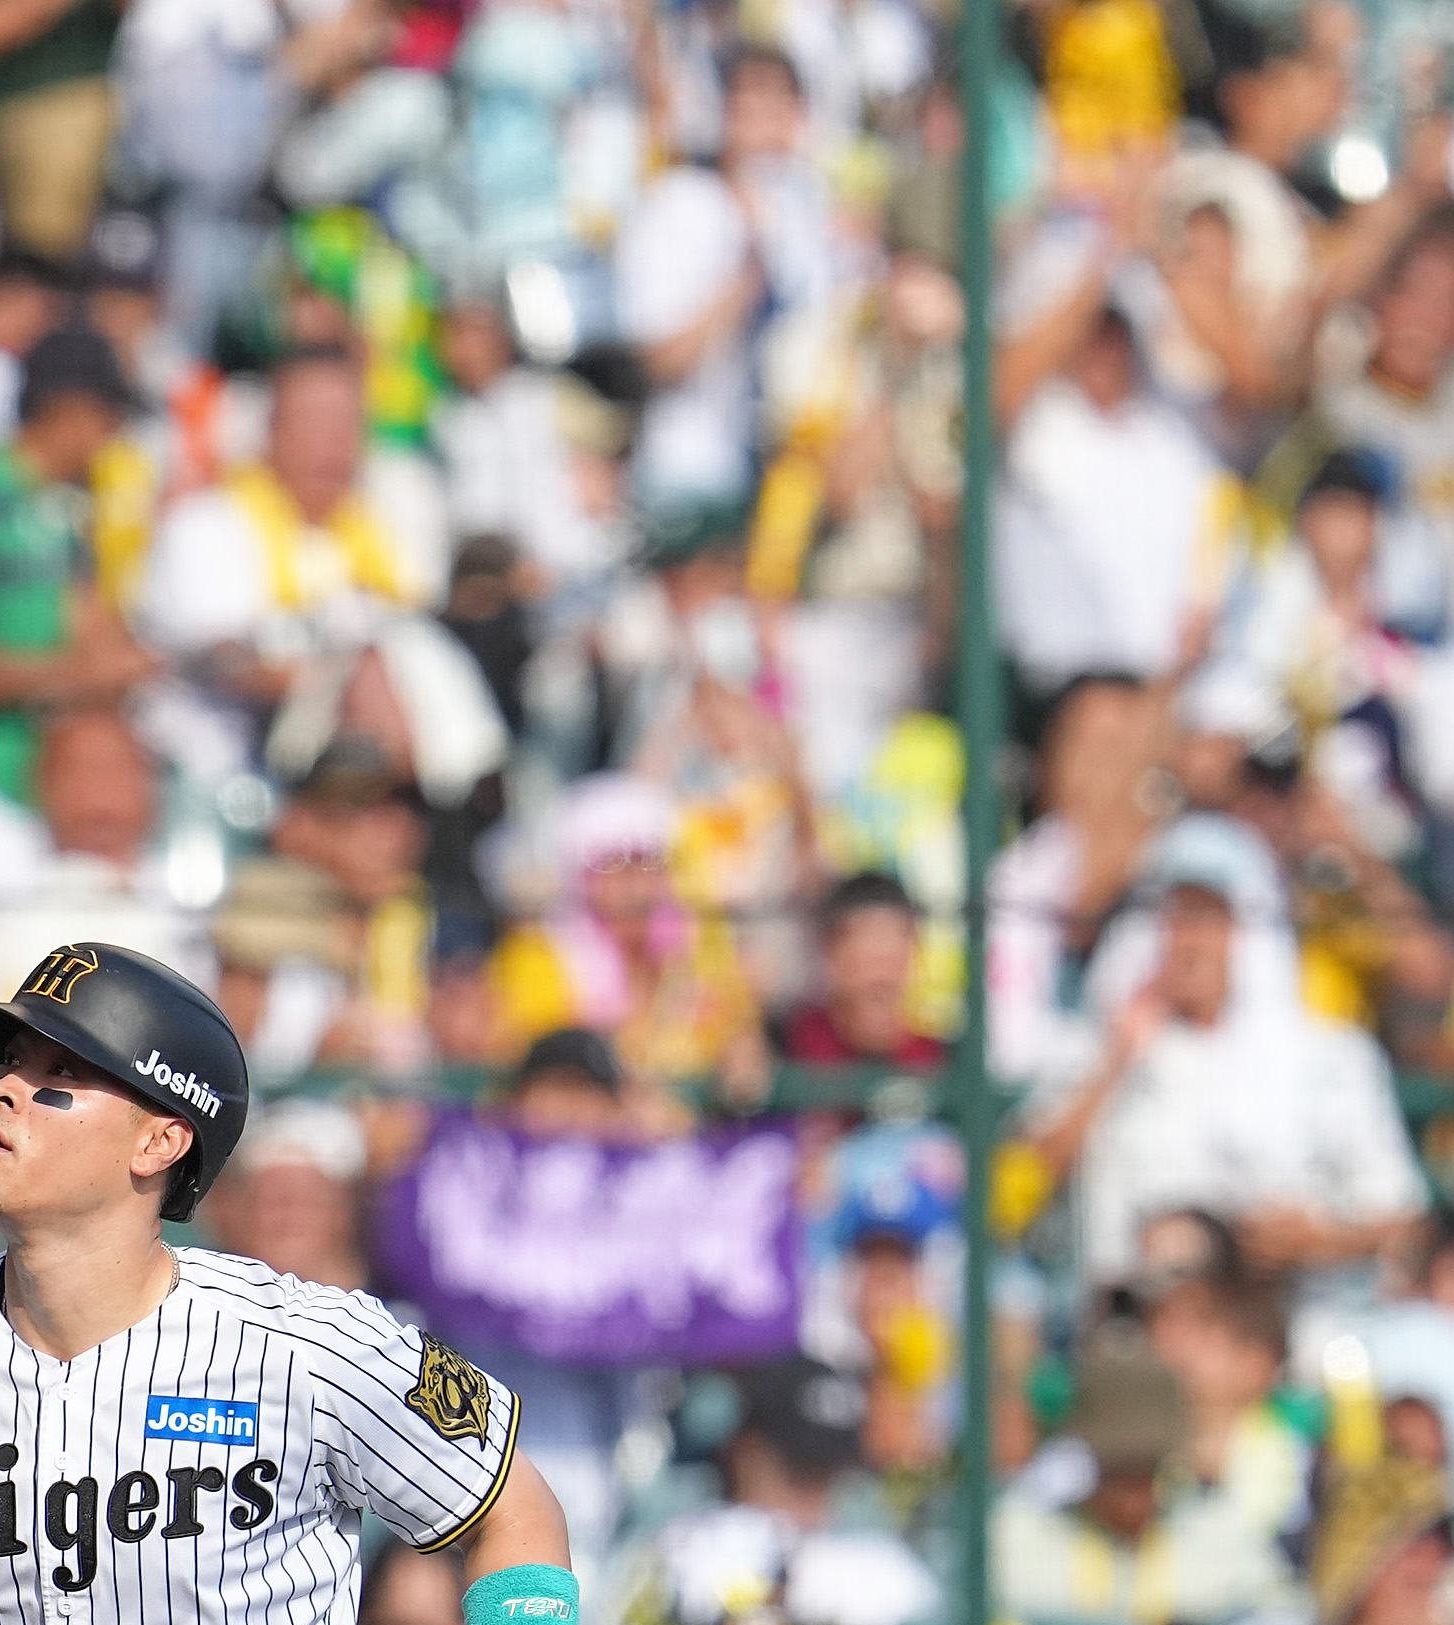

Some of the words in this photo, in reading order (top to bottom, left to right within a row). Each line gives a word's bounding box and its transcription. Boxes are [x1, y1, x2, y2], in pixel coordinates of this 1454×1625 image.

[134, 1048, 223, 1119] Joshin
[147, 1403, 255, 1438] Joshin
[501, 1597, 572, 1620] TERU
